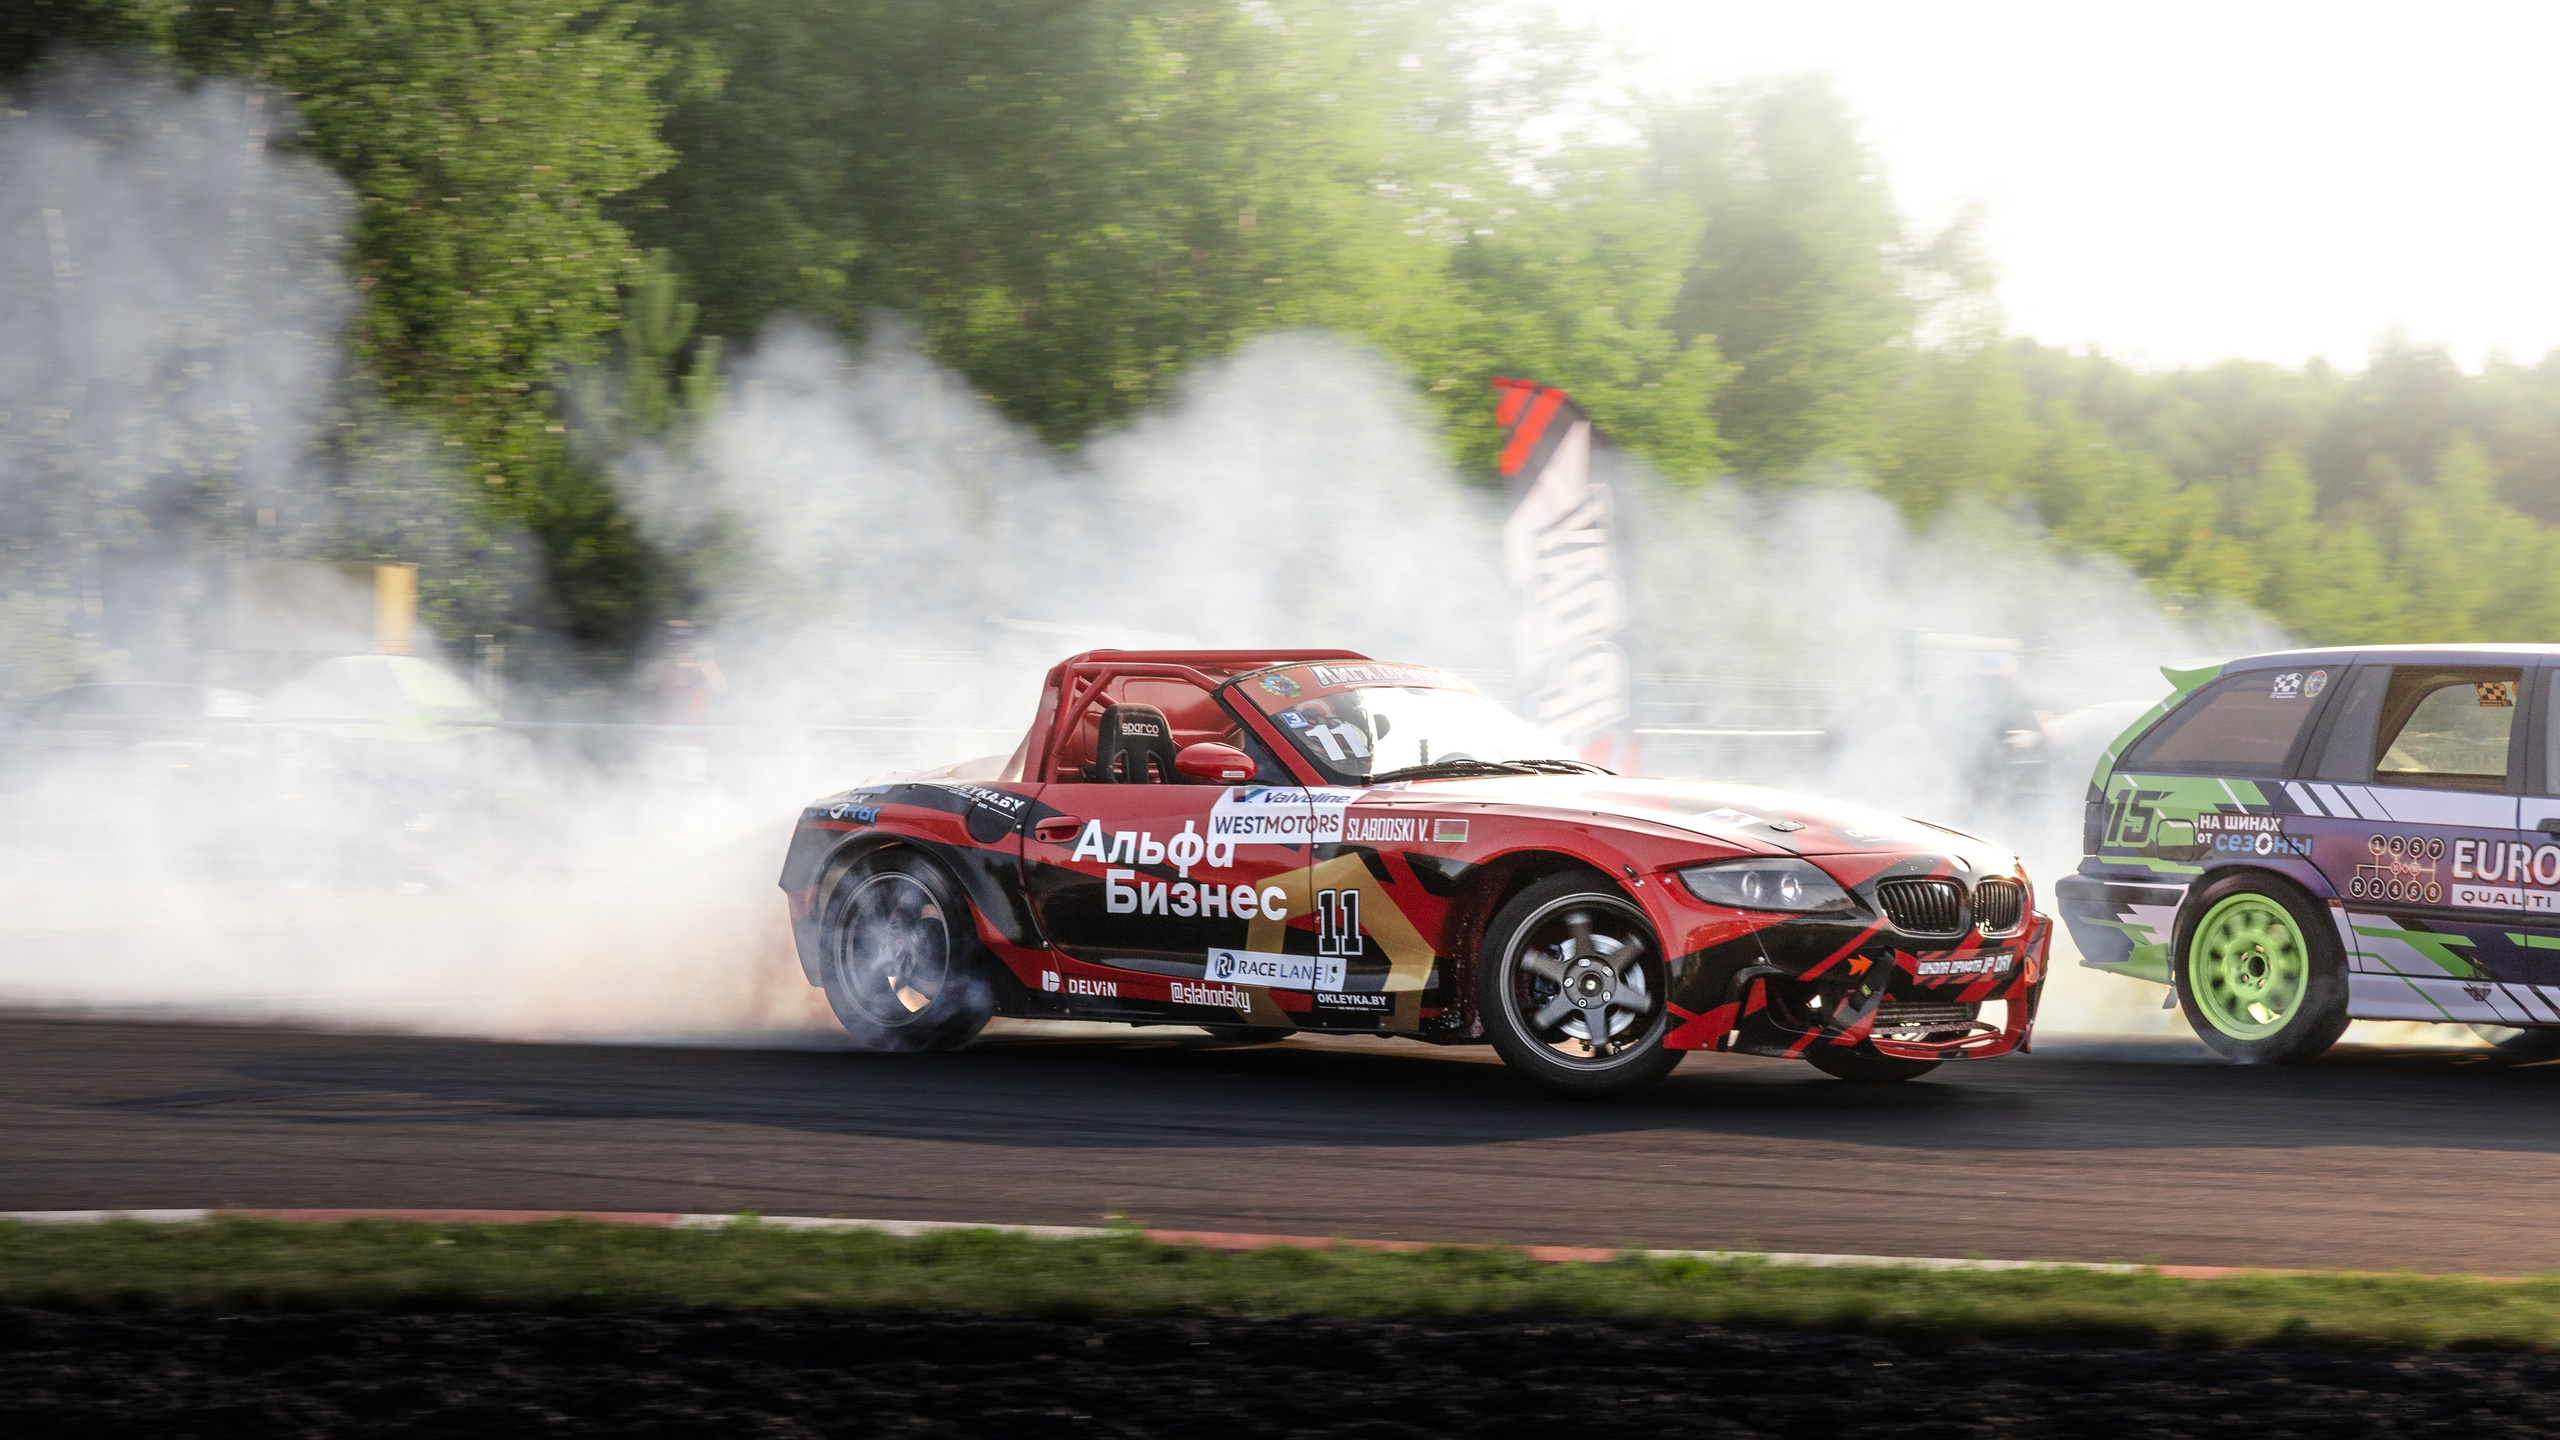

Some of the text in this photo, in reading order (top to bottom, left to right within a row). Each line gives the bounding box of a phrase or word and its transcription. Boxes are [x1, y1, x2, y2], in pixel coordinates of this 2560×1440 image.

[1122, 722, 1159, 736] sparco
[1305, 724, 1371, 761] 11
[1265, 792, 1351, 803] Valvoline
[1215, 814, 1339, 834] WESTMOTORS
[1347, 818, 1429, 842] SLABODSKI V.
[2104, 789, 2166, 846] 15
[2200, 815, 2281, 831] НА ШИНАХ
[1071, 818, 1235, 878] Альфа
[2453, 839, 2560, 886] EURO
[1106, 868, 1288, 921] Бизнес
[1317, 888, 1363, 956] 11
[1238, 960, 1323, 981] RACE LANE
[1170, 982, 1251, 1013] @slabodsky
[1317, 993, 1387, 1006] OKLEYKA.BY
